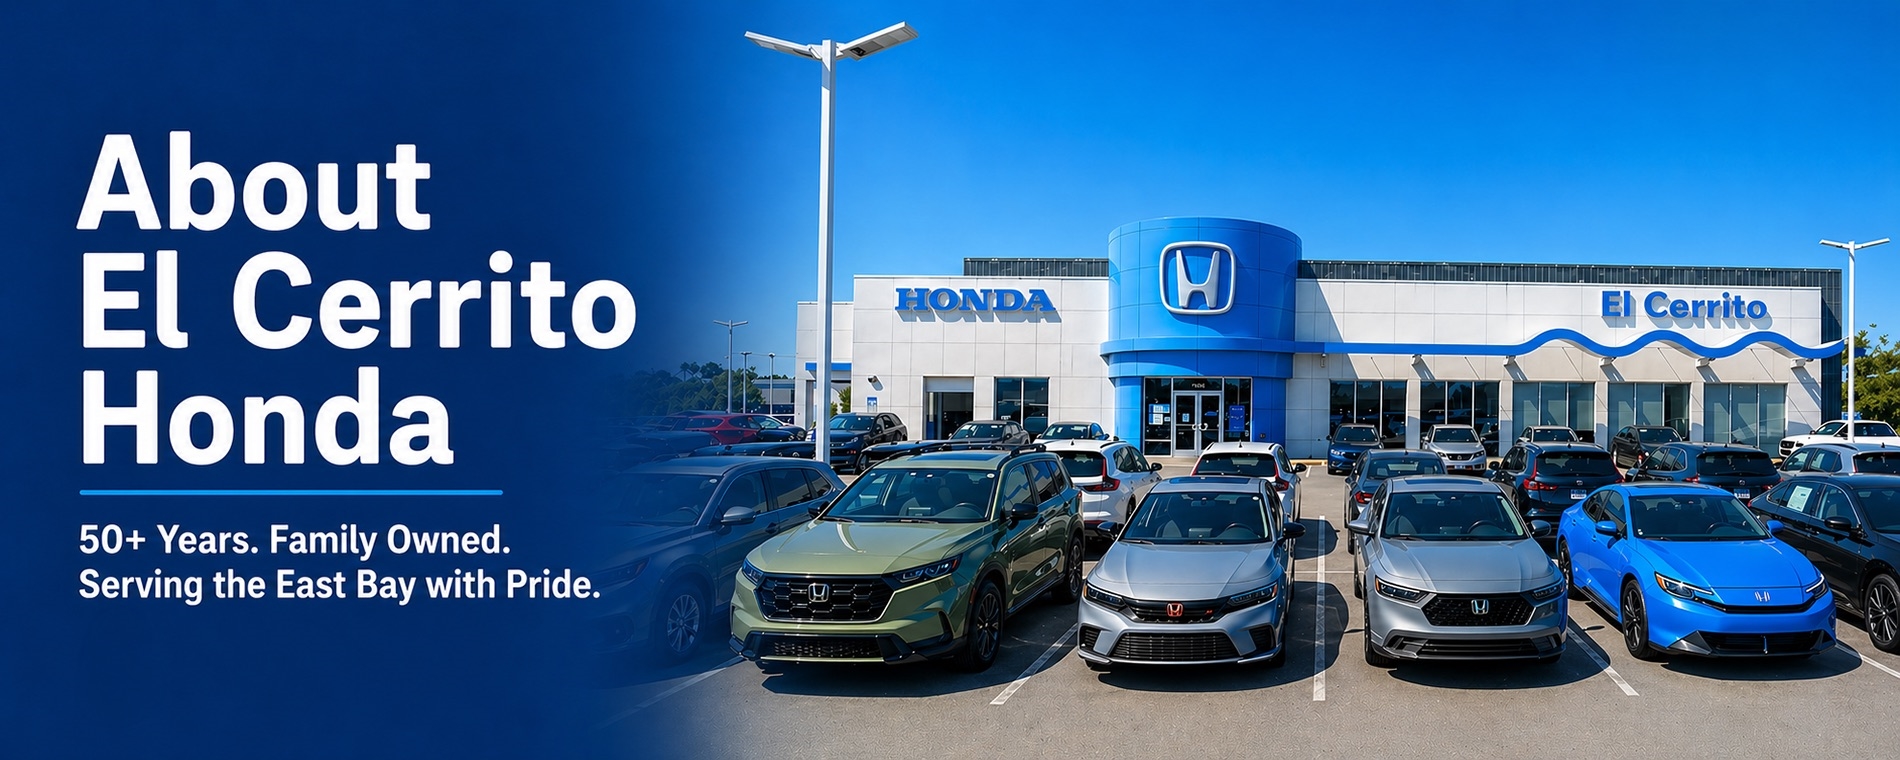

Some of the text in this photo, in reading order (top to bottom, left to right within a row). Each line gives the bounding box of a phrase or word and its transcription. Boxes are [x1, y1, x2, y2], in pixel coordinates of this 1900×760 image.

[894, 287, 1057, 312] HONDA
[1602, 290, 1768, 319] El Cerrito
